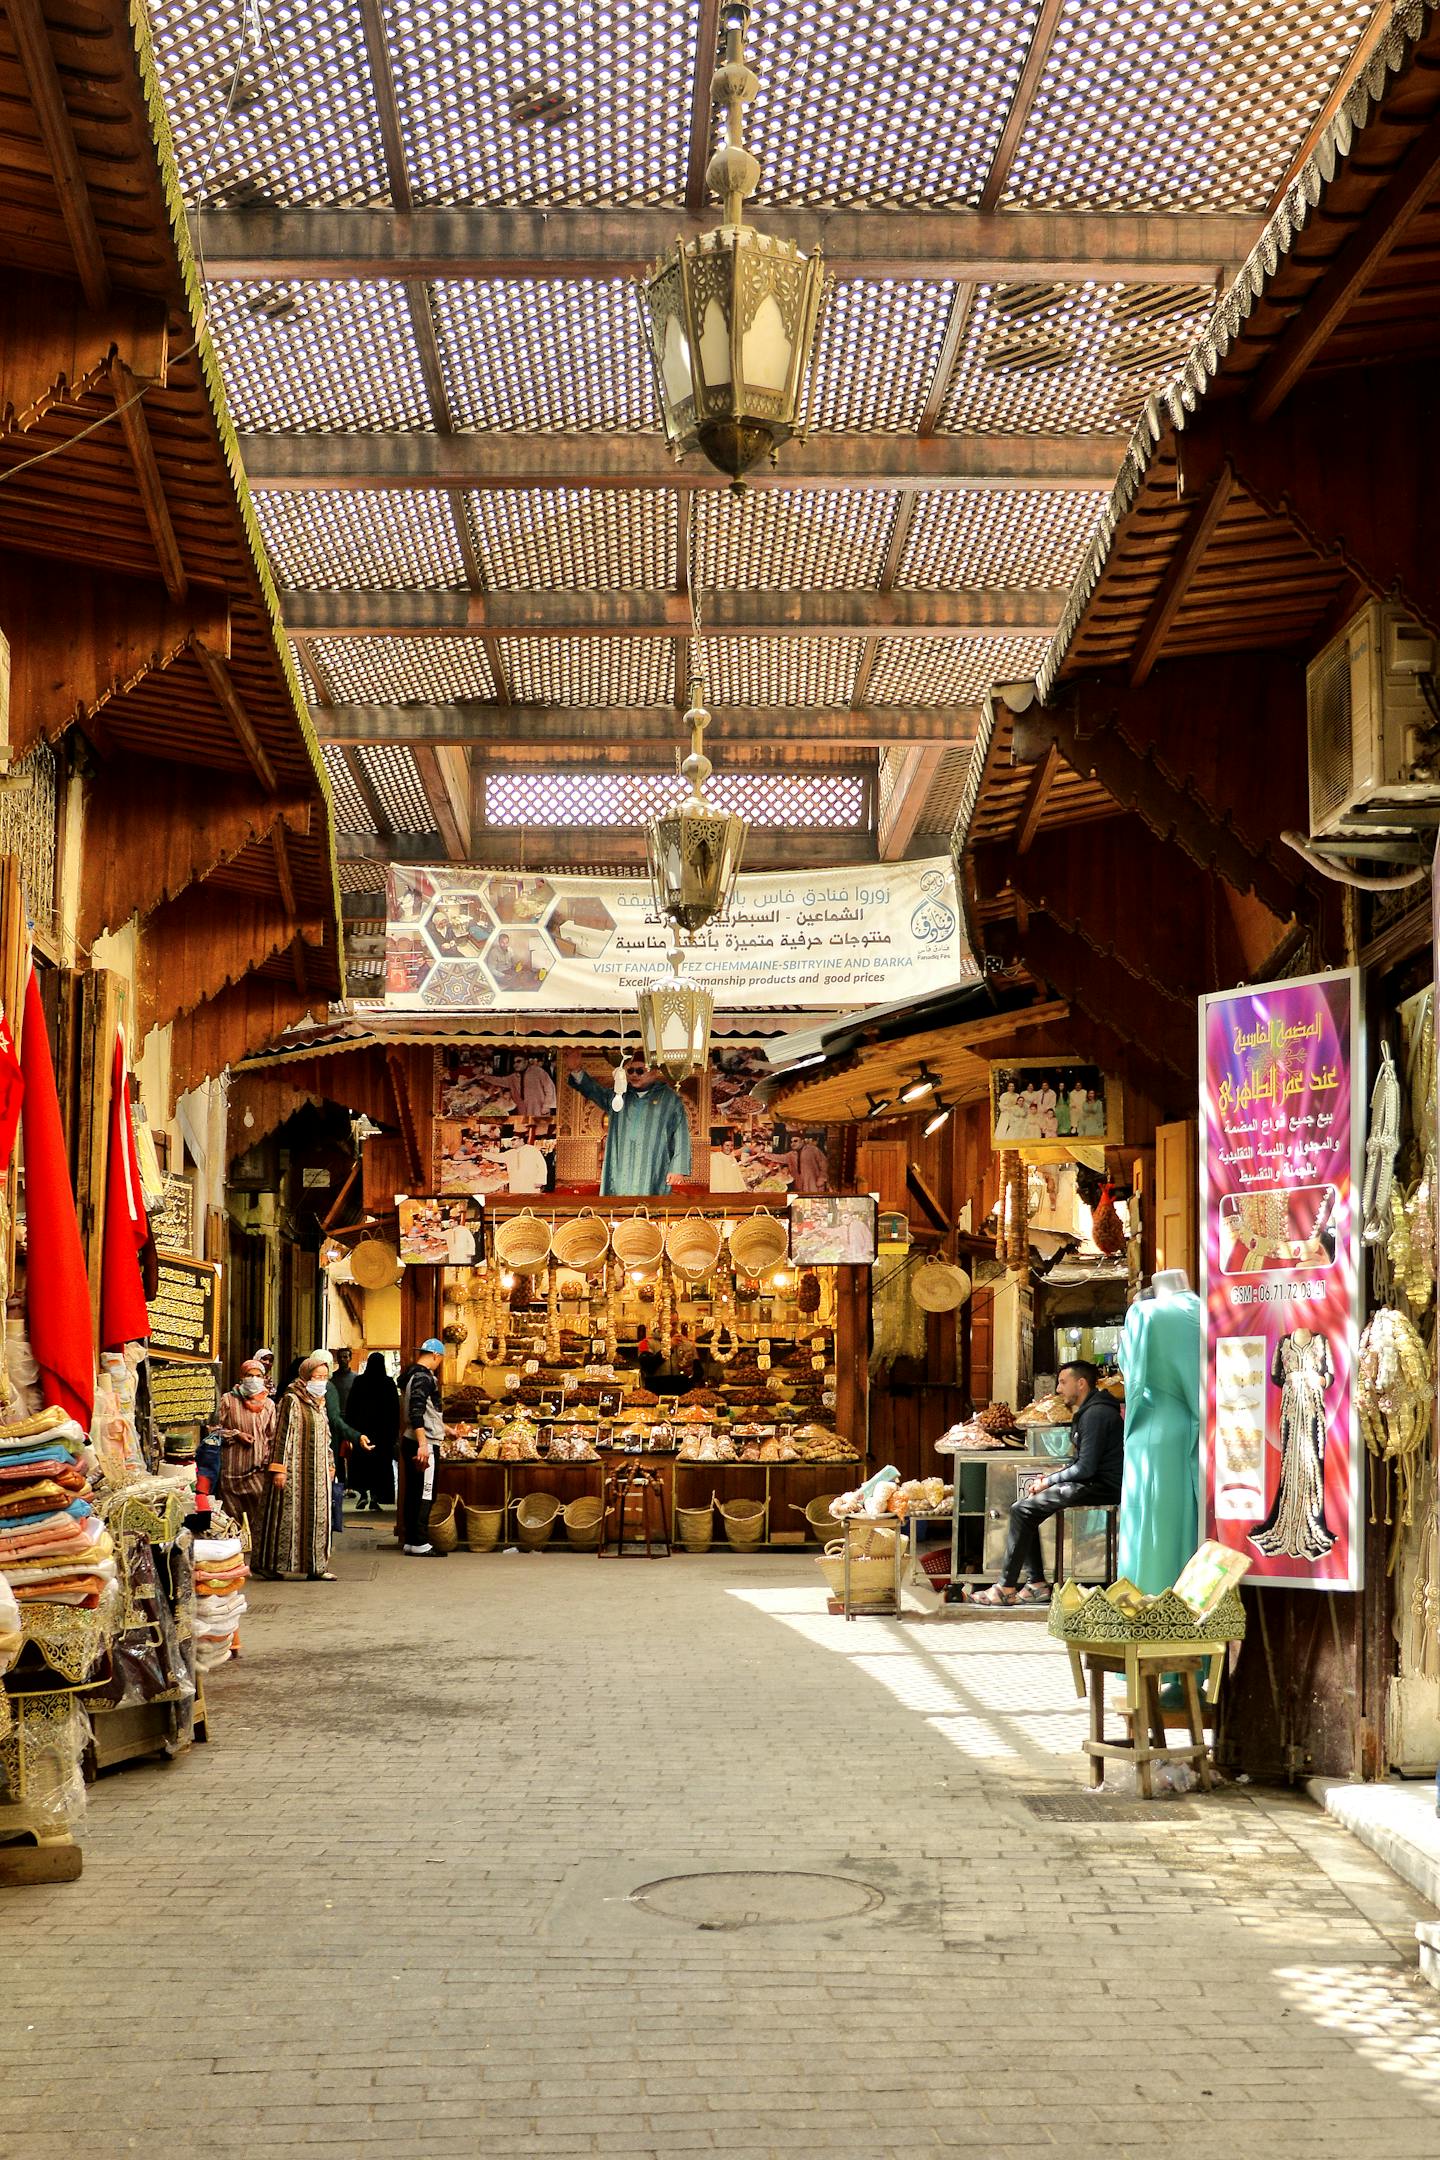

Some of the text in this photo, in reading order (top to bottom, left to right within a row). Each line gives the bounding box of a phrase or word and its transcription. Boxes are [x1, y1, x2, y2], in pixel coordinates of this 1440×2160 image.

[753, 888, 795, 908] فاس
[802, 887, 849, 906] فنادق
[855, 886, 891, 904] زوروا
[796, 907, 865, 926] الشماعين
[615, 936, 667, 953] مناسبة
[725, 933, 774, 951] متميزة
[780, 931, 823, 950] حرفية
[829, 931, 892, 948] منتوجات
[593, 962, 623, 973] VISIT
[681, 961, 703, 972] FEZ
[845, 958, 871, 970] AND
[873, 957, 914, 969] BARKA
[748, 974, 796, 986] products
[799, 973, 820, 984] and
[823, 973, 851, 985] good
[853, 972, 885, 984] prices
[1308, 1065, 1339, 1091] عند
[1224, 1118, 1258, 1133] المضمة
[1288, 1115, 1314, 1132] جميع
[1316, 1112, 1333, 1128] بيع
[1218, 1146, 1252, 1164] التقليدية
